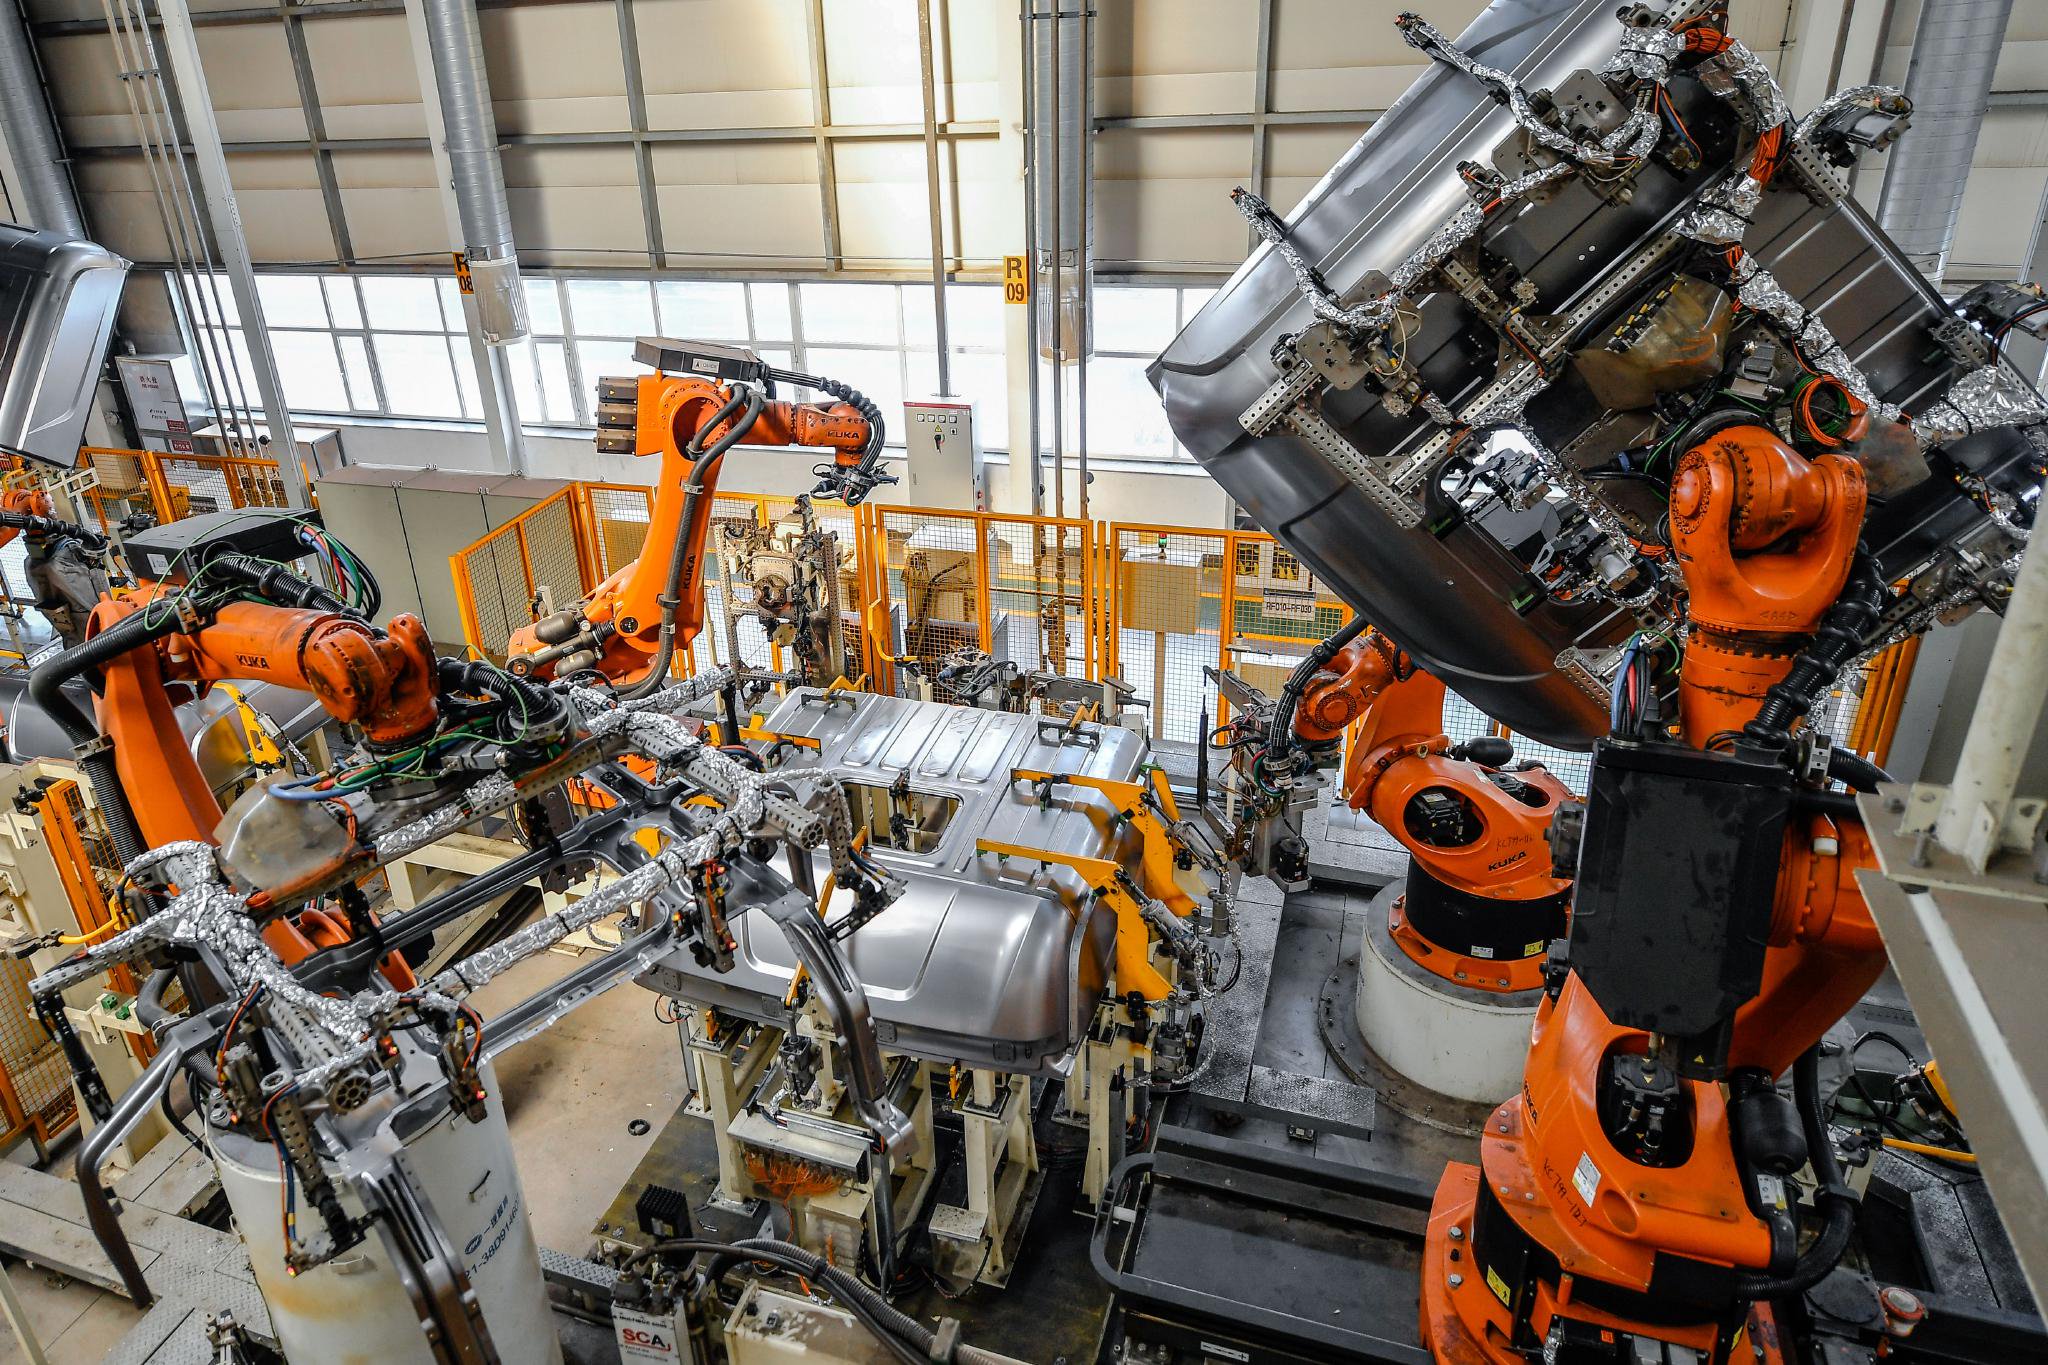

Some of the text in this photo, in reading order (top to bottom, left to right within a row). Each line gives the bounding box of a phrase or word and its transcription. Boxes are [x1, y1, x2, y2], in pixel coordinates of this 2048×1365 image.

[454, 254, 470, 272] R
[1006, 257, 1023, 279] R
[459, 275, 474, 291] 08
[1006, 282, 1025, 302] 09
[827, 431, 860, 440] KUKA
[235, 654, 271, 670] KUKA
[1488, 851, 1527, 872] KUKA
[622, 1328, 666, 1348] SCA
